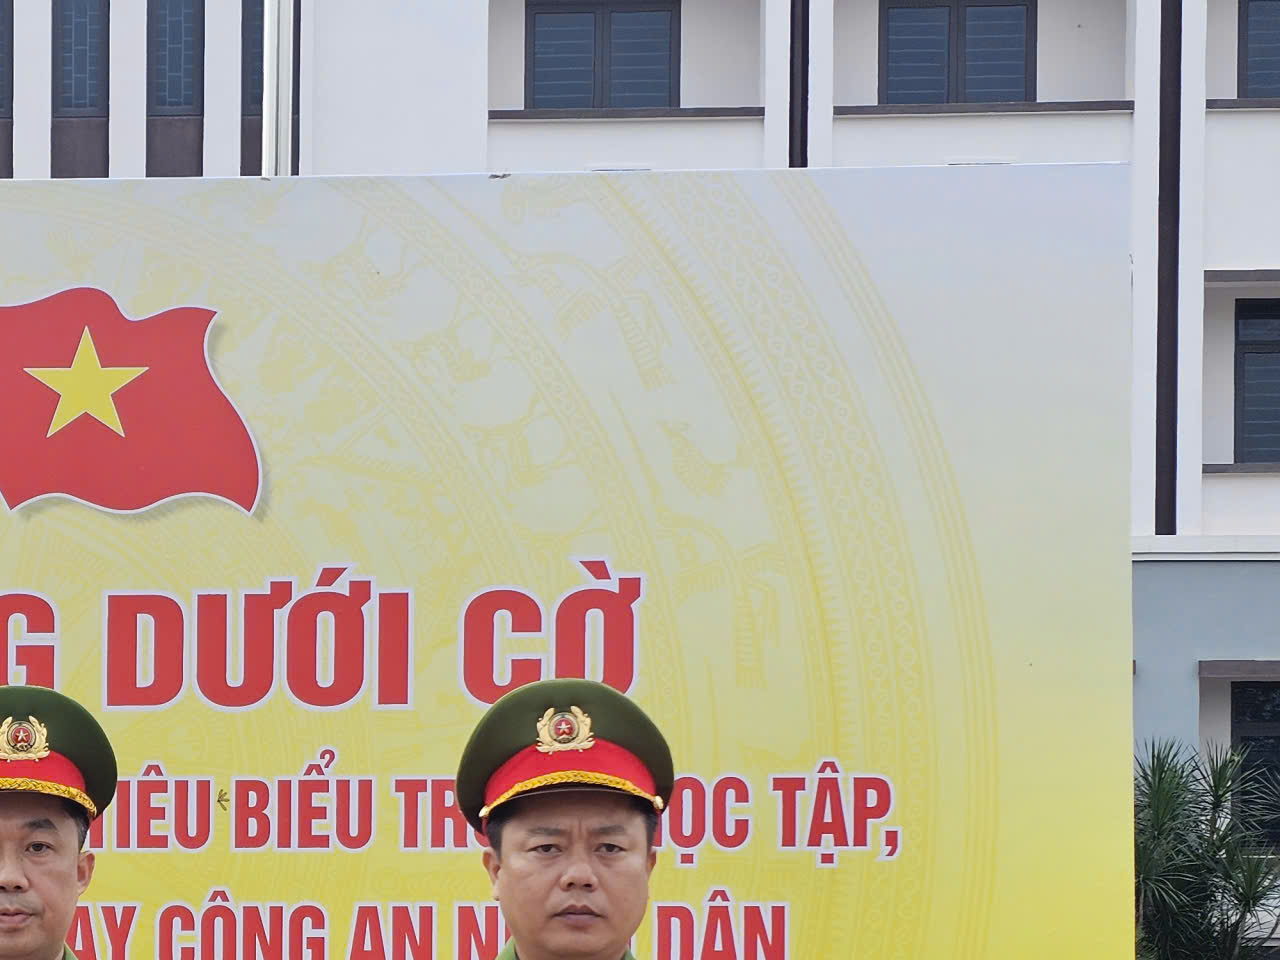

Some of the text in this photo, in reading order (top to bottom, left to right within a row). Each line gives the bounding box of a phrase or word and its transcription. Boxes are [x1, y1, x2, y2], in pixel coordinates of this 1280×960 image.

[106, 568, 413, 707] DƯỚI
[463, 561, 642, 704] CỜ
[233, 750, 356, 850] BIỂU
[653, 776, 748, 865] ỌC
[771, 762, 902, 864] TẬP,
